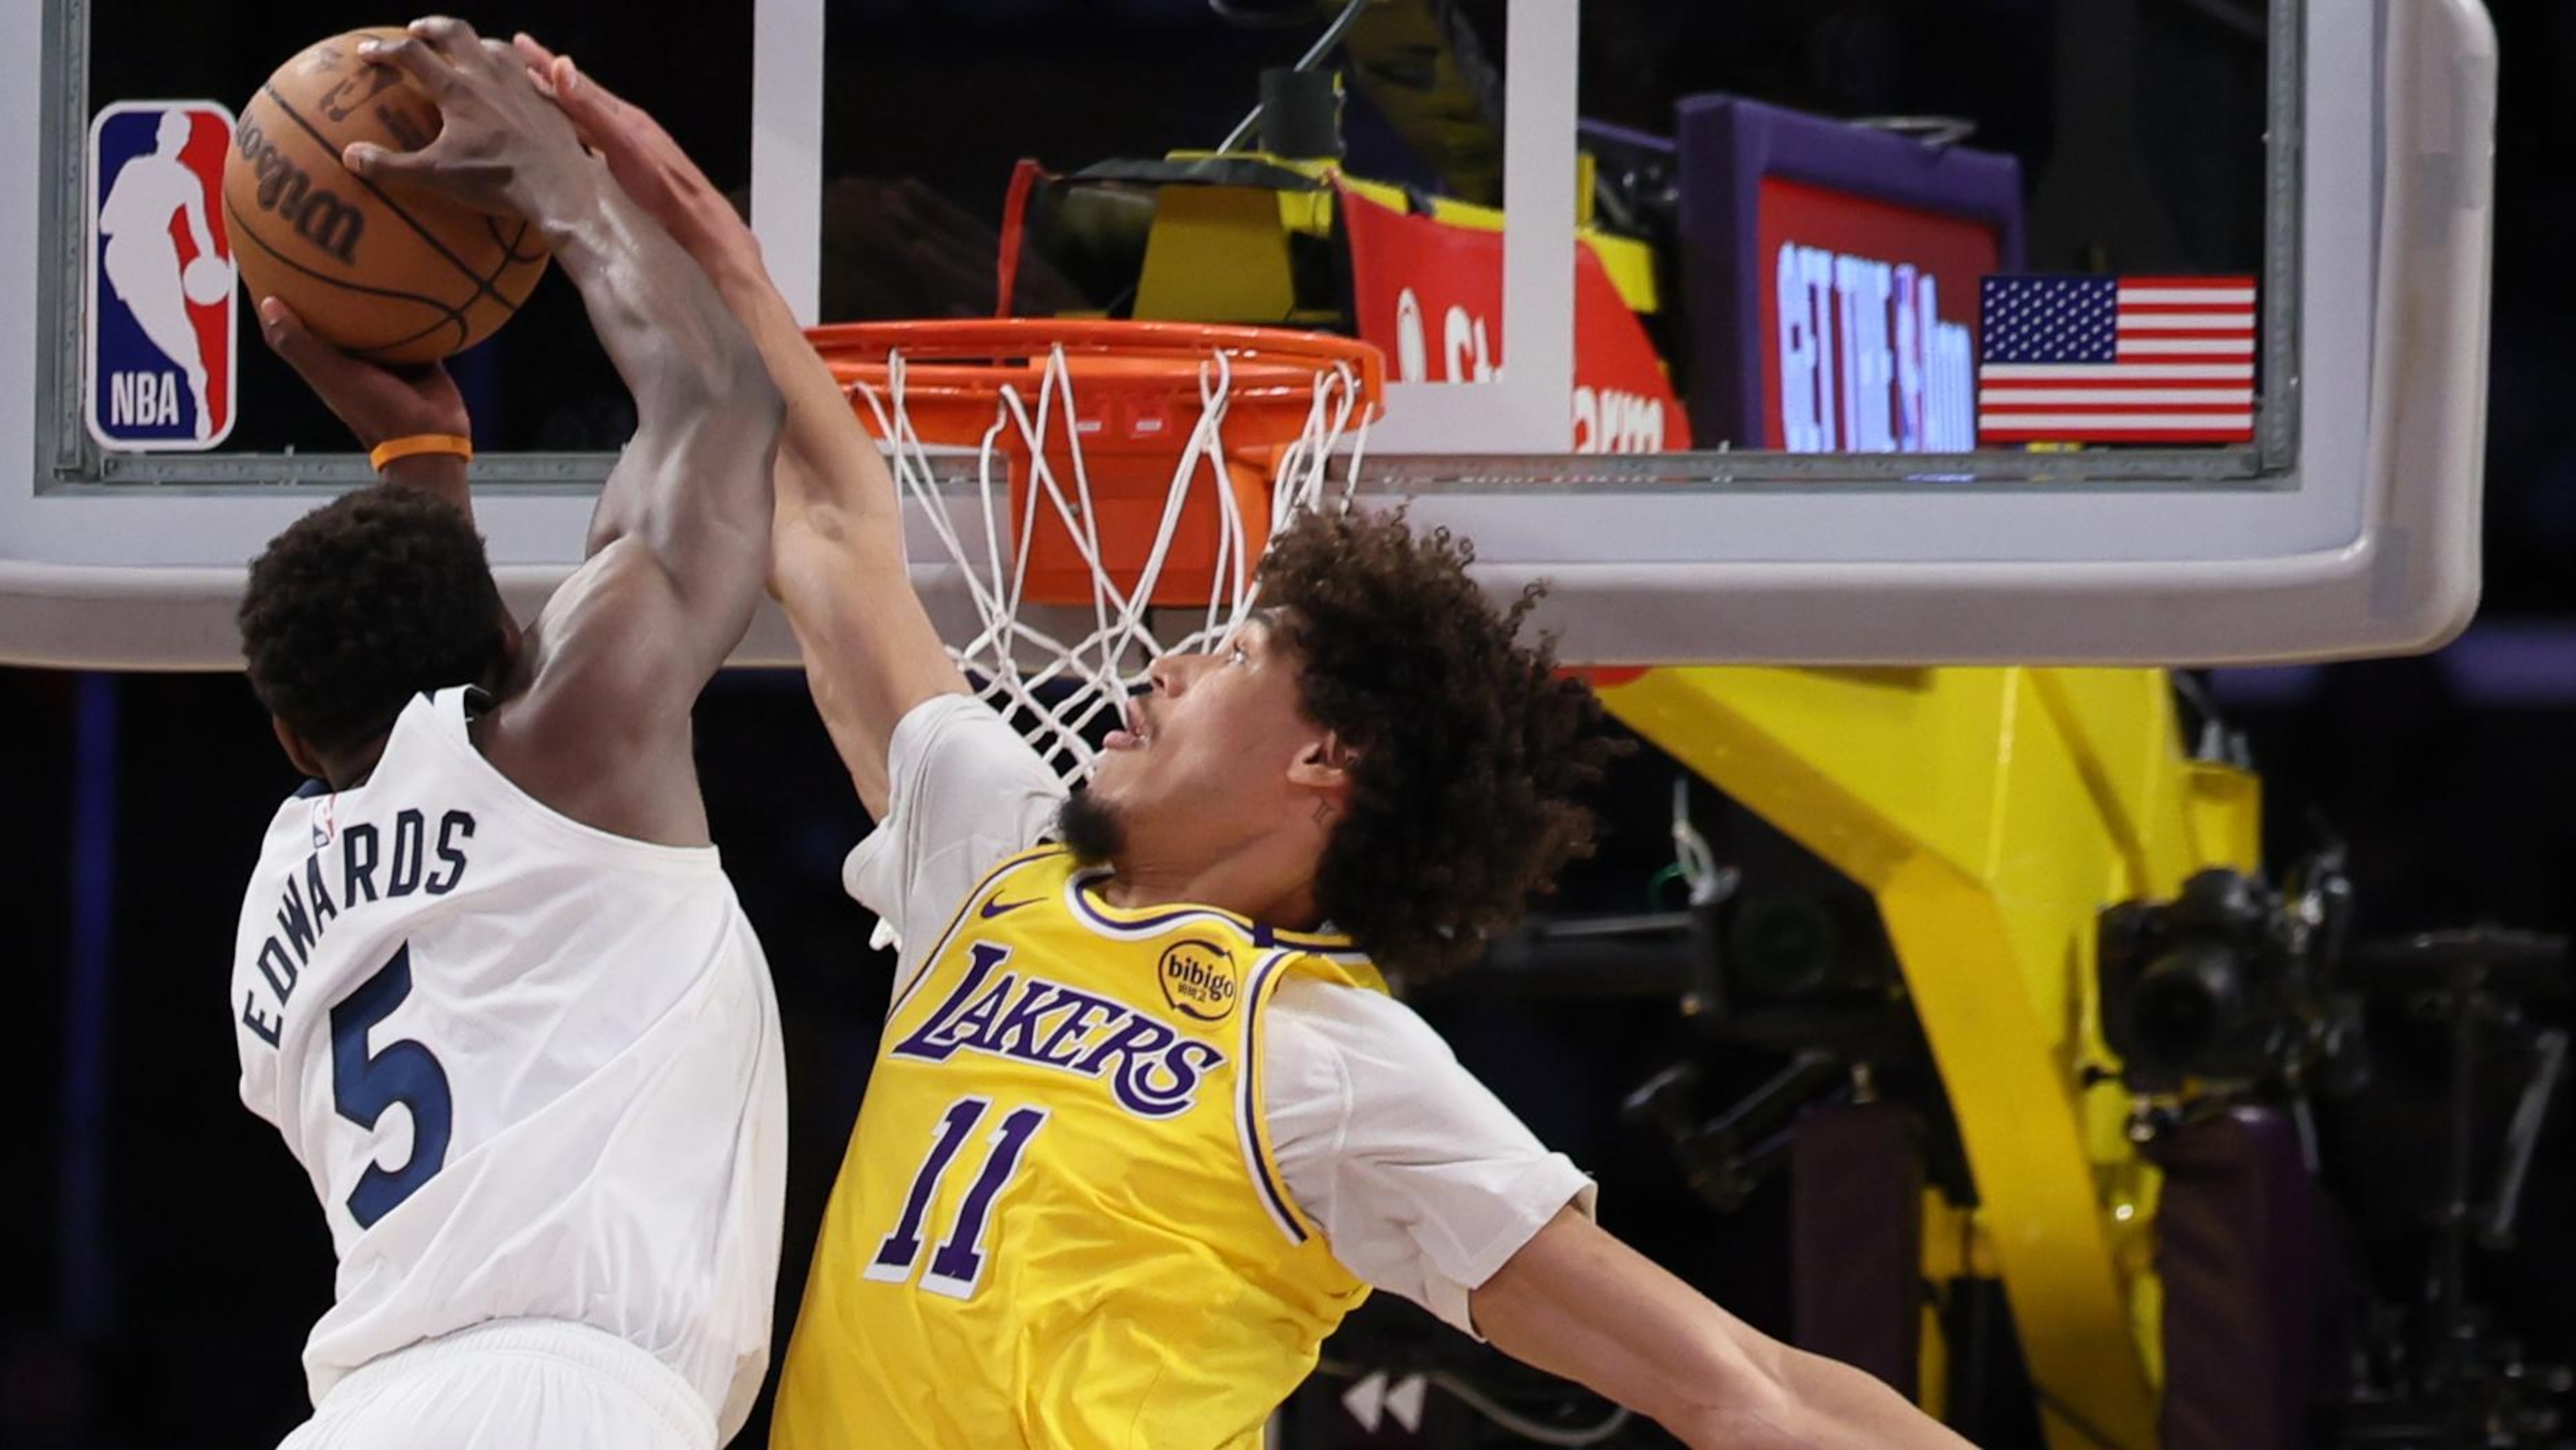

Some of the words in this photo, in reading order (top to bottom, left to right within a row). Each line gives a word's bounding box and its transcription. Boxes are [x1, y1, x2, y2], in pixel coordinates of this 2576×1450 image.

[111, 372, 180, 427] NBA
[1573, 386, 1664, 454] arm
[243, 809, 475, 1049] EDWARDS
[1169, 954, 1234, 1002] bibigo
[330, 937, 453, 1229] 5
[889, 942, 1229, 1119] LAKERS
[864, 1095, 1051, 1300] 11
